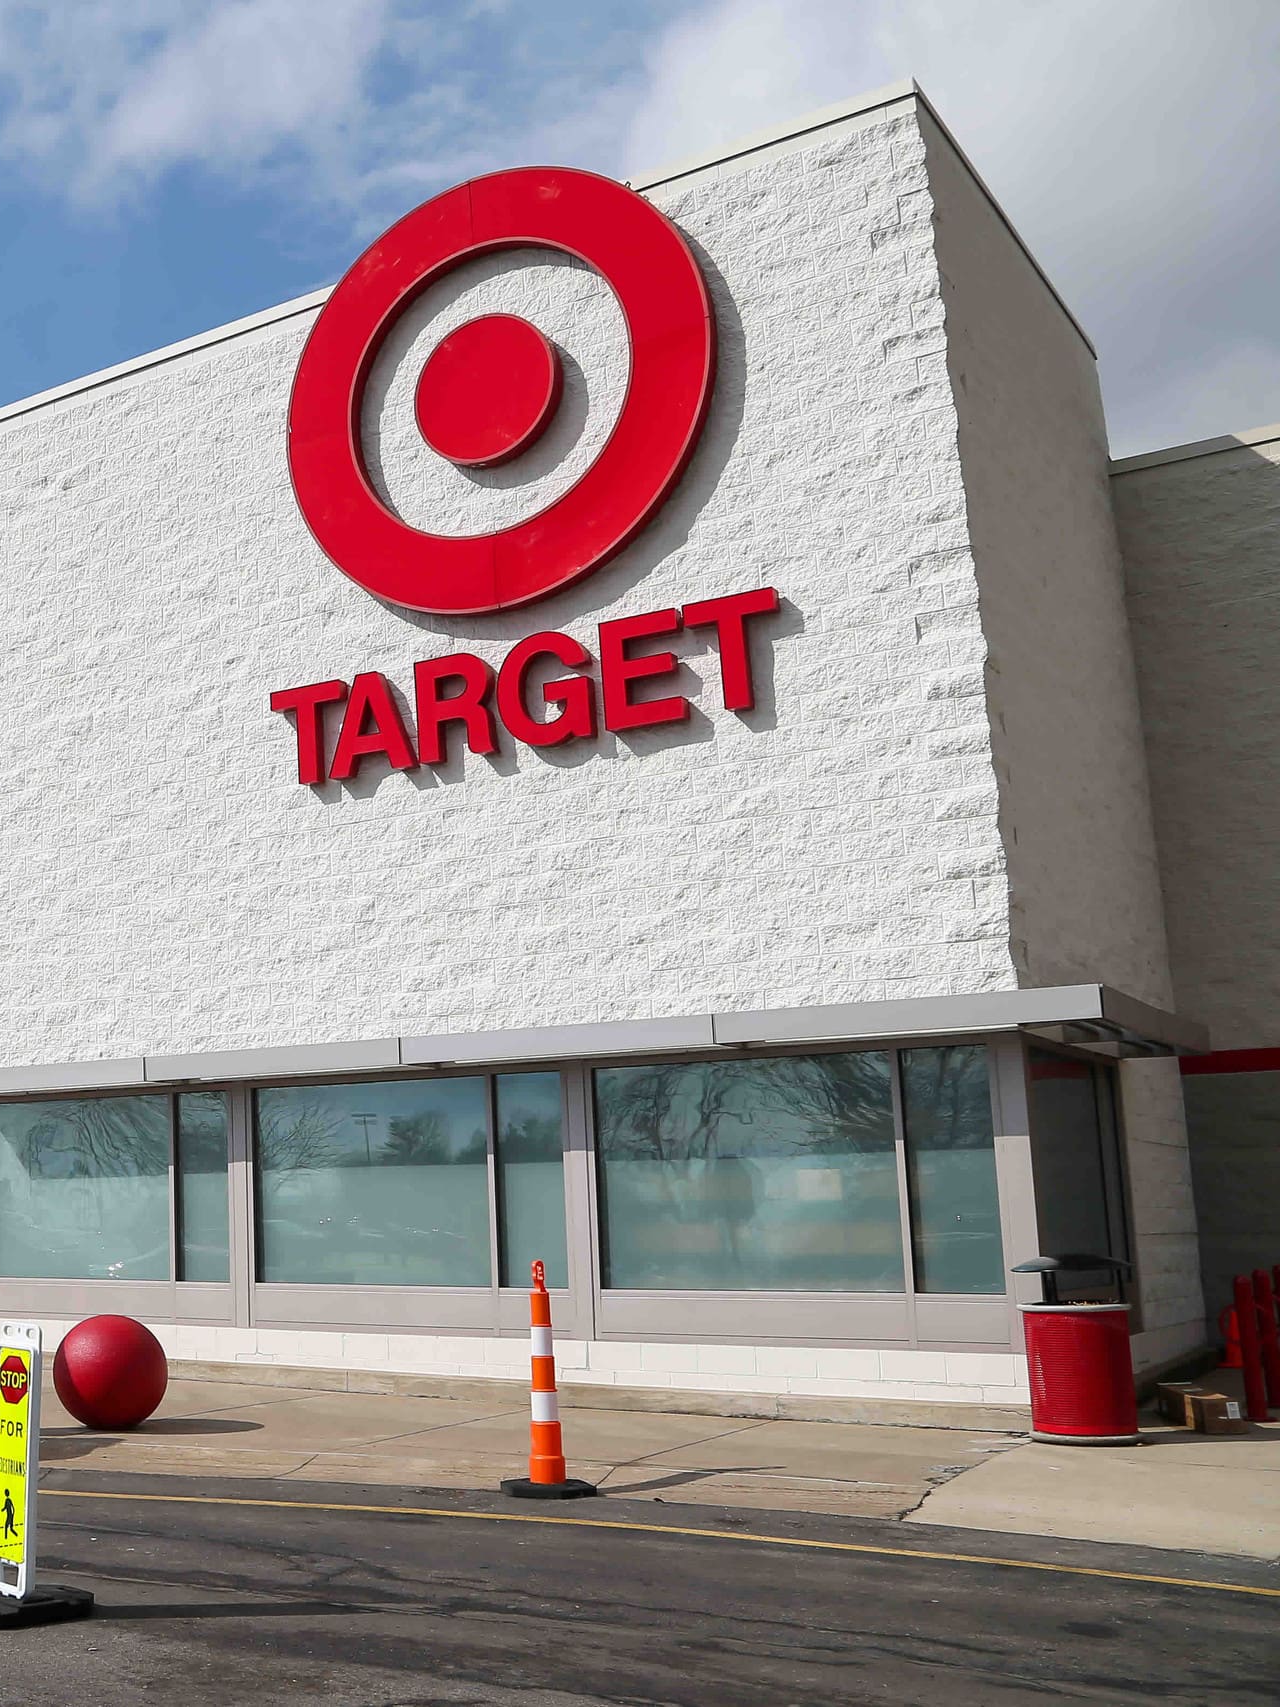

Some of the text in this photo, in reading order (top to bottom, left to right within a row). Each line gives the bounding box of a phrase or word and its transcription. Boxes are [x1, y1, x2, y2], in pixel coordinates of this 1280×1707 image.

[270, 586, 780, 785] TARGET
[0, 1370, 27, 1389] STOP
[0, 1419, 23, 1438] FOR
